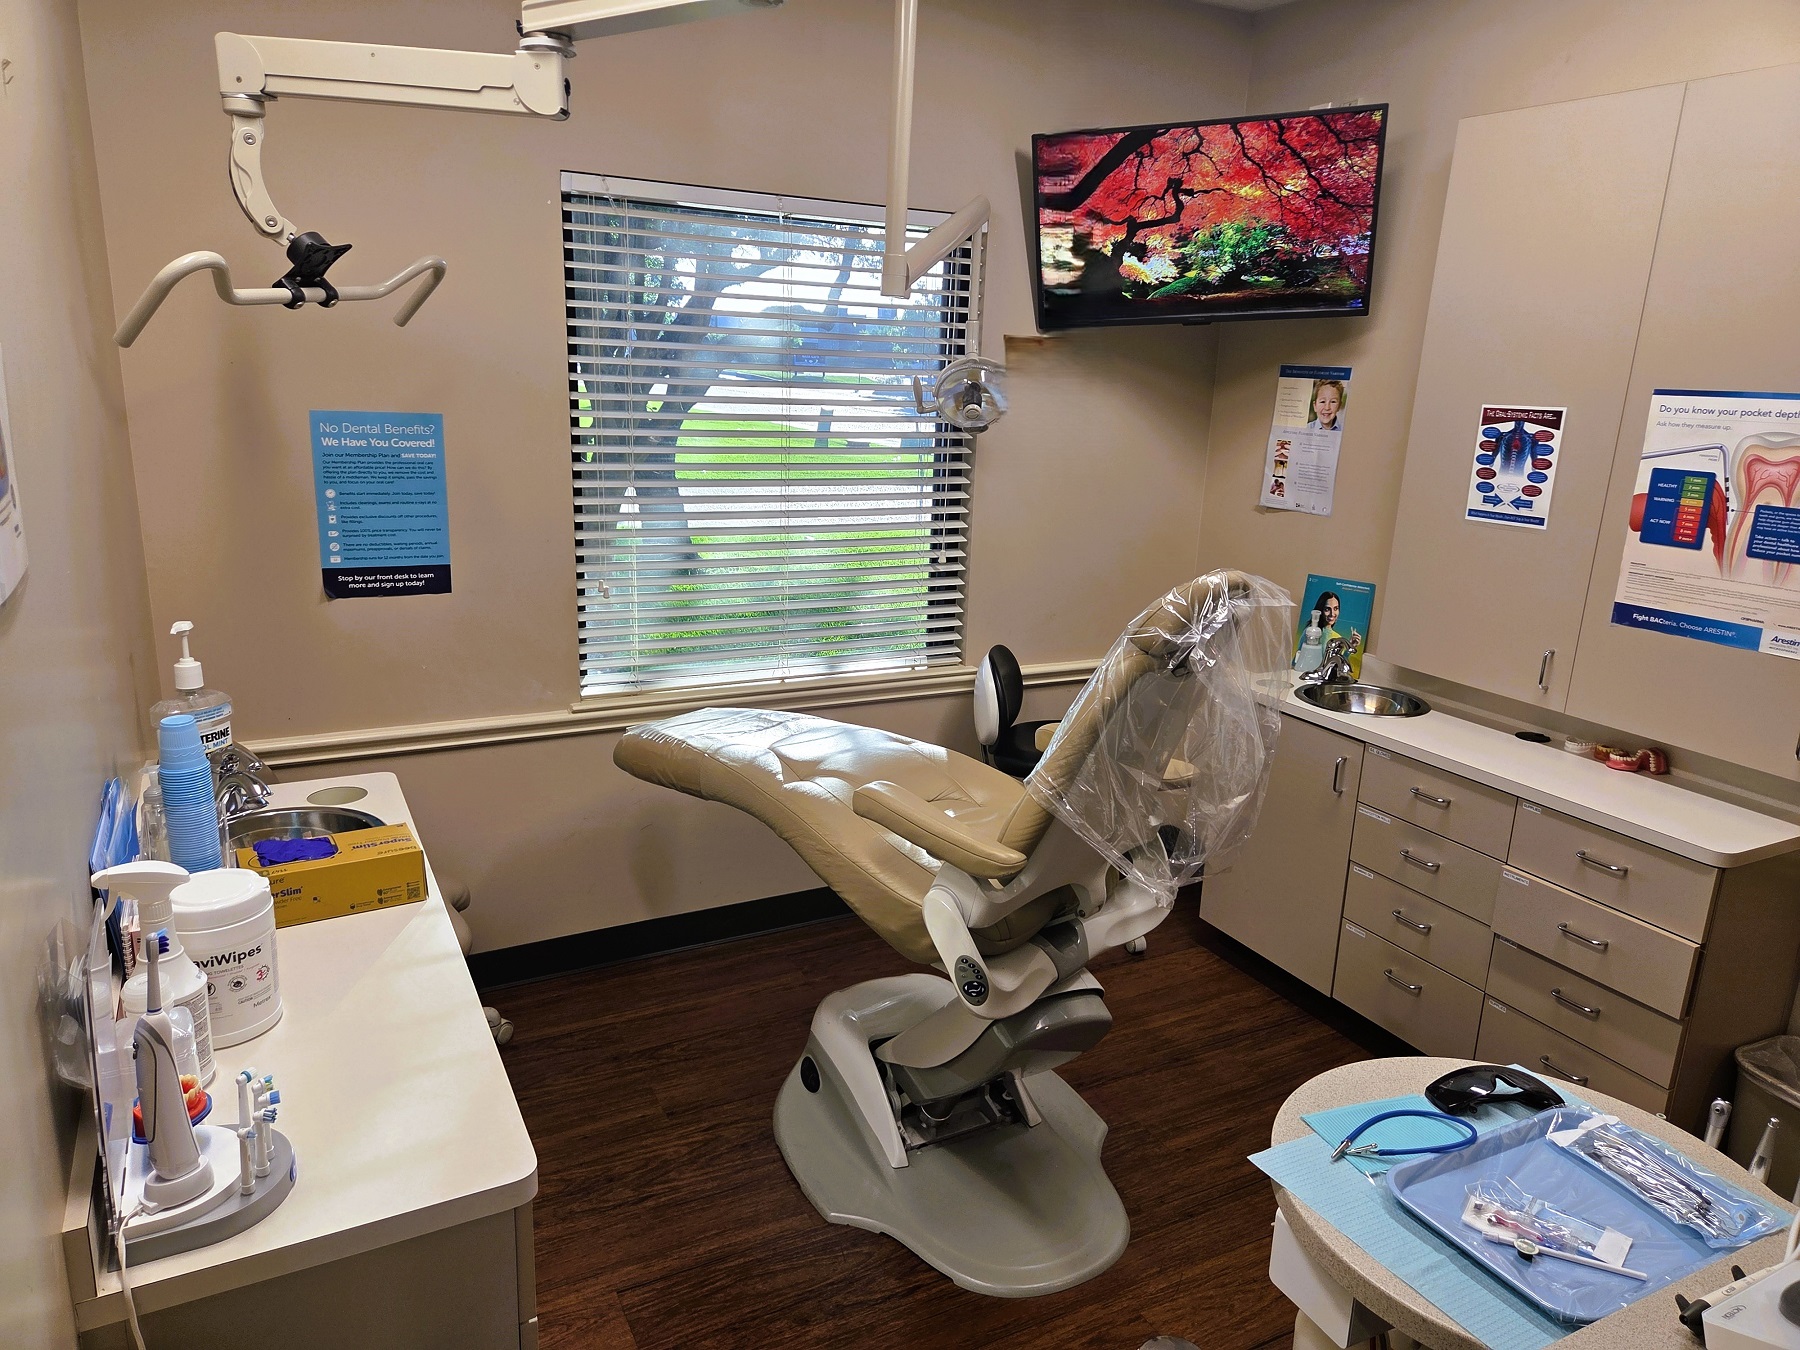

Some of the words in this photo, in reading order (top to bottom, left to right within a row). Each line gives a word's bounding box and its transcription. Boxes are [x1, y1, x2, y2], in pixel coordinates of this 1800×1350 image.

[1660, 404, 1671, 413] Do
[1673, 406, 1689, 415] you
[1692, 406, 1715, 414] know
[1717, 408, 1738, 417] your
[1740, 408, 1772, 418] pocket
[320, 422, 338, 433] No
[342, 423, 381, 434] Dental
[384, 424, 435, 434] Benefits?
[321, 437, 339, 446] We
[341, 438, 367, 446] Have
[369, 438, 388, 447] You
[391, 439, 435, 447] Covered!
[1633, 613, 1649, 621] Fight
[1650, 617, 1677, 626] BACteria.
[1680, 622, 1703, 631] Choose
[200, 727, 230, 744] TERINE
[213, 738, 228, 748] MINT
[271, 887, 302, 898] erSlim
[193, 945, 261, 968] aviWipes
